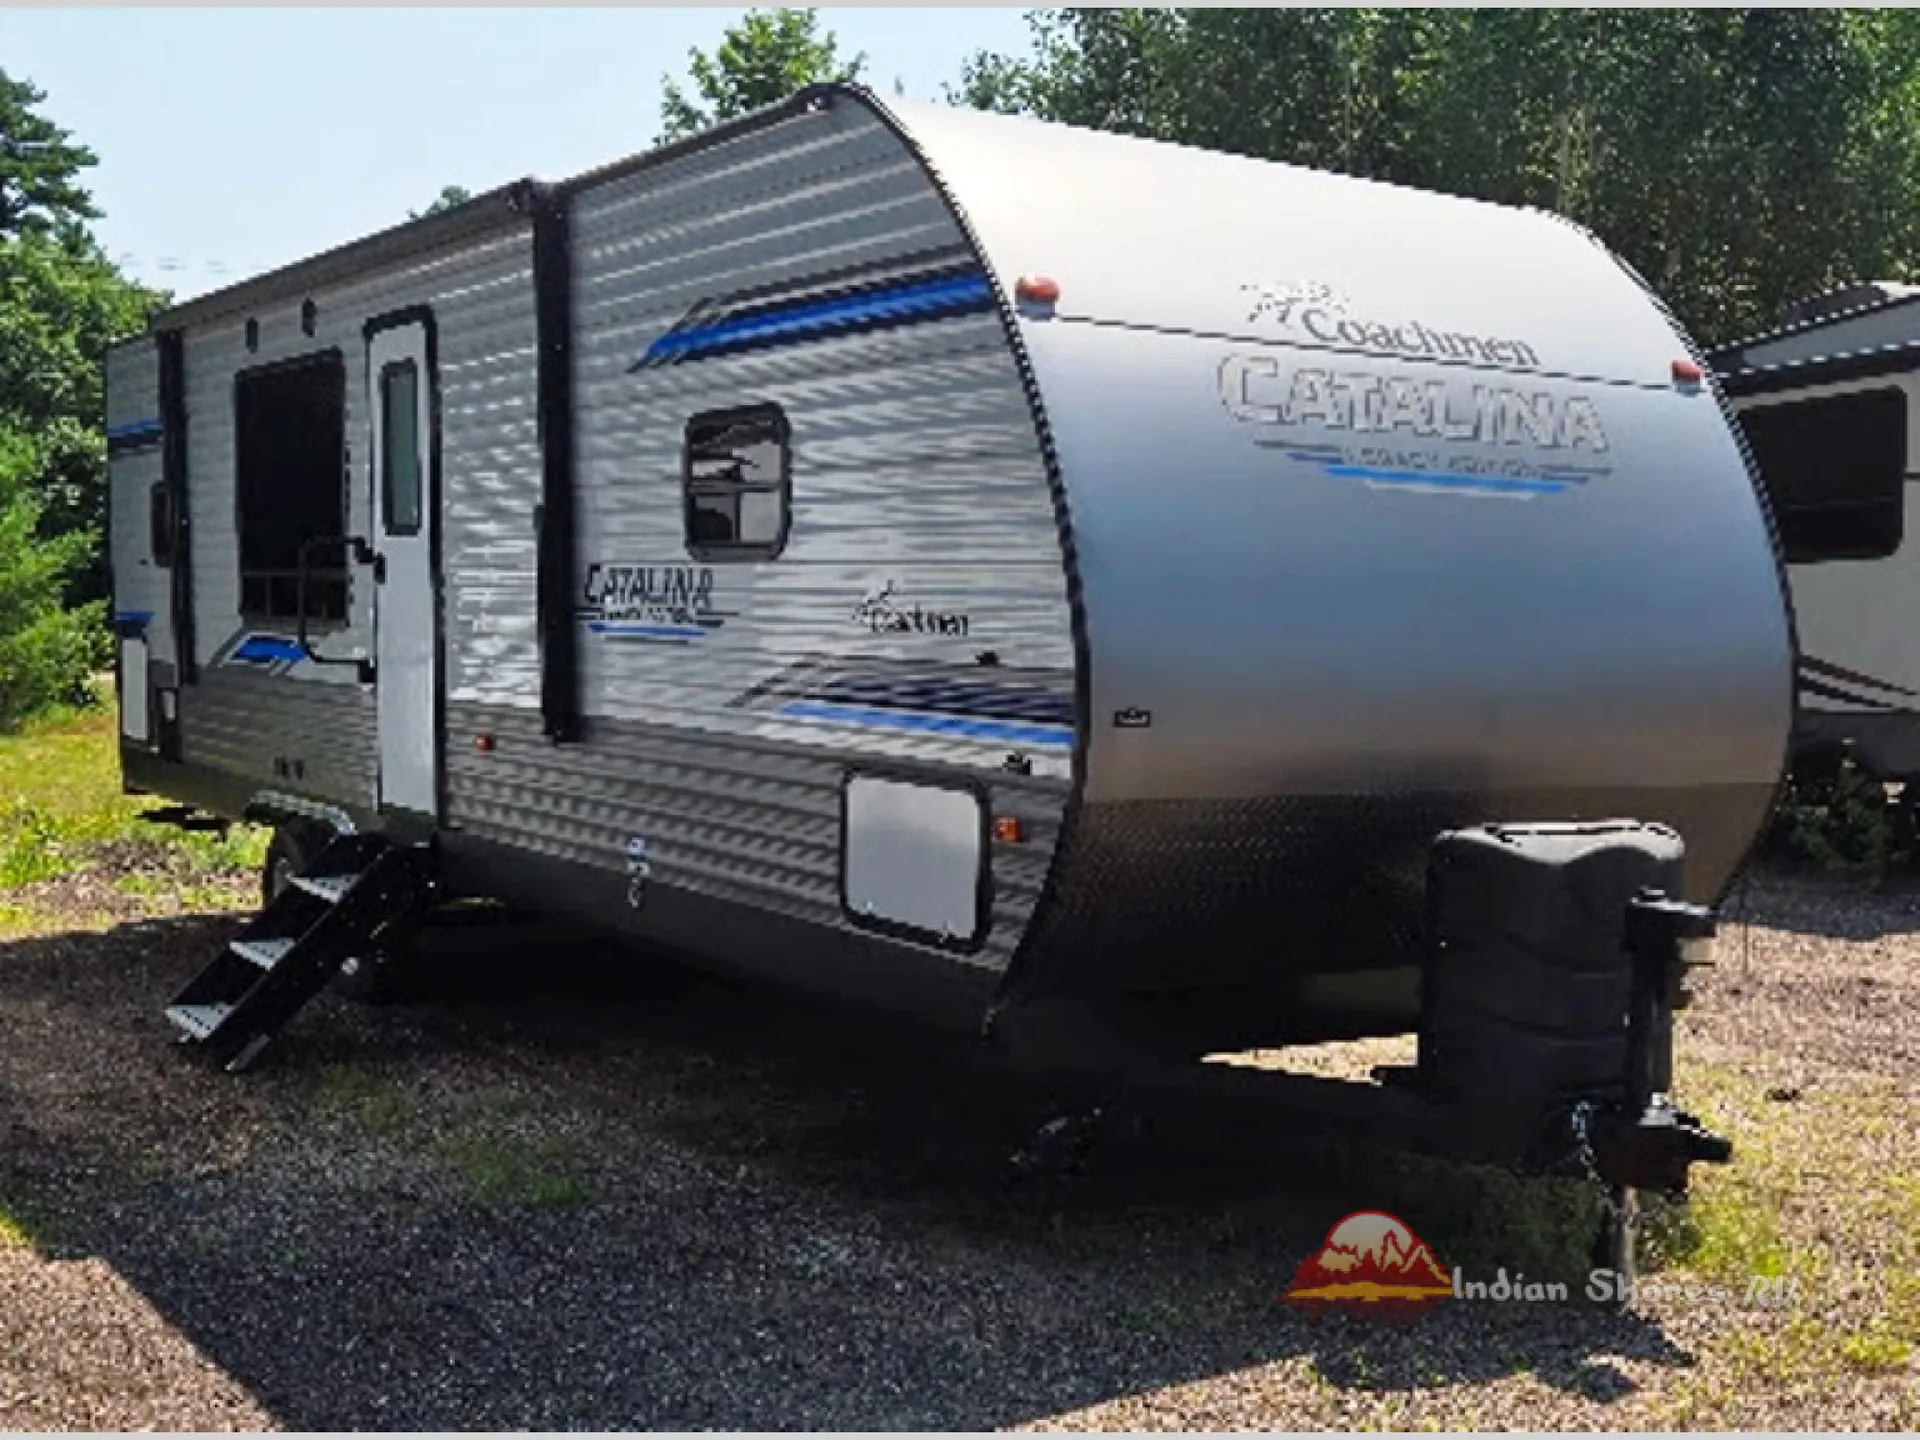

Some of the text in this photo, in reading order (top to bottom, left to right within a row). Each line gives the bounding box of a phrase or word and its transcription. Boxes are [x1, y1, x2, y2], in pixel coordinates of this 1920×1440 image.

[1302, 307, 1542, 366] Coachmen
[1216, 352, 1611, 453] CATALINA
[585, 563, 714, 612] CATALINA
